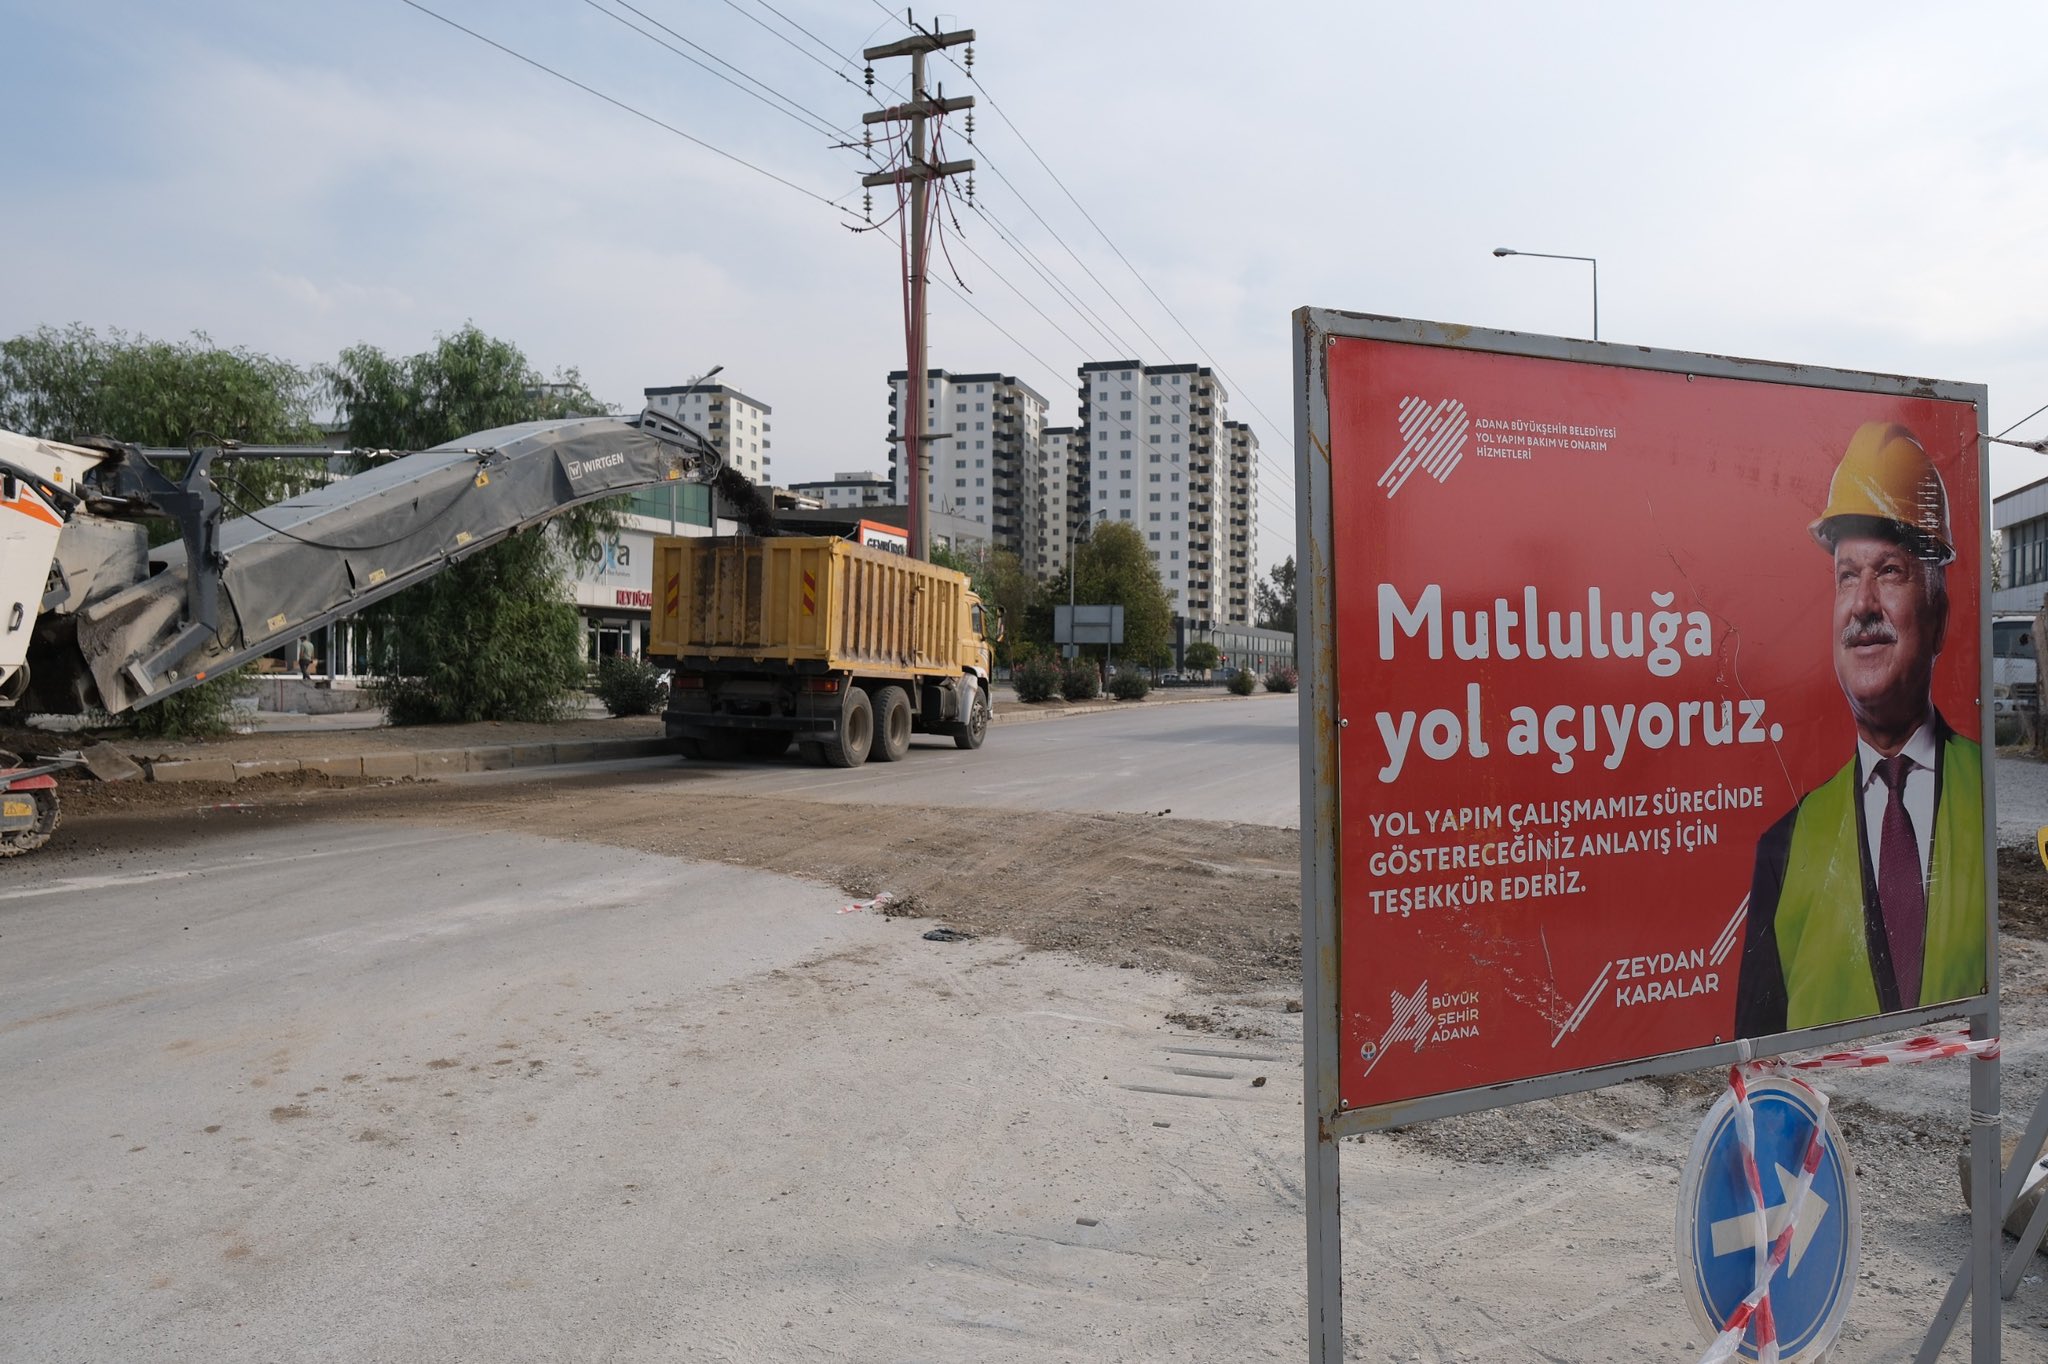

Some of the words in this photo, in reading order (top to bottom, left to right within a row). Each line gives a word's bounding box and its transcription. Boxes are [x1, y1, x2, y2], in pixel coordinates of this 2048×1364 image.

[1475, 418, 1509, 431] ADANA
[1511, 419, 1568, 436] BÜYÜKŞEHİR
[1569, 426, 1617, 438] BELEDİYESİ
[1475, 432, 1495, 444] YOL
[1496, 434, 1526, 446] YAPIM
[1527, 436, 1556, 448] BAKIM
[1557, 438, 1569, 449] VE
[1570, 440, 1608, 452] ONARIM
[582, 452, 624, 473] WIRTGEN
[1476, 445, 1532, 460] HİZMETLERİ
[1377, 583, 1712, 677] Mutluluğa
[1375, 683, 1490, 783] yol
[1507, 699, 1784, 774] açıyoruz.
[1369, 813, 1420, 838] YOL
[1425, 805, 1502, 833] YAPIM
[1508, 794, 1648, 832] ÇALIŞMAMIZ
[1652, 783, 1764, 816] SÜRECİNDE
[1369, 830, 1575, 877] GÖSTERECEĞİNİZ
[1579, 826, 1671, 857] ANLAYIŞ
[1676, 819, 1719, 852] İÇİN
[1369, 876, 1494, 918] TEŞEKKÜR
[1500, 866, 1587, 901] EDERİZ.
[1616, 948, 1705, 981] ZEYDAN
[1432, 991, 1479, 1009] BÜYÜK
[1616, 973, 1719, 1008] KARALAR
[1437, 1007, 1479, 1030] ŞEHİR
[1431, 1025, 1480, 1043] ADANA
